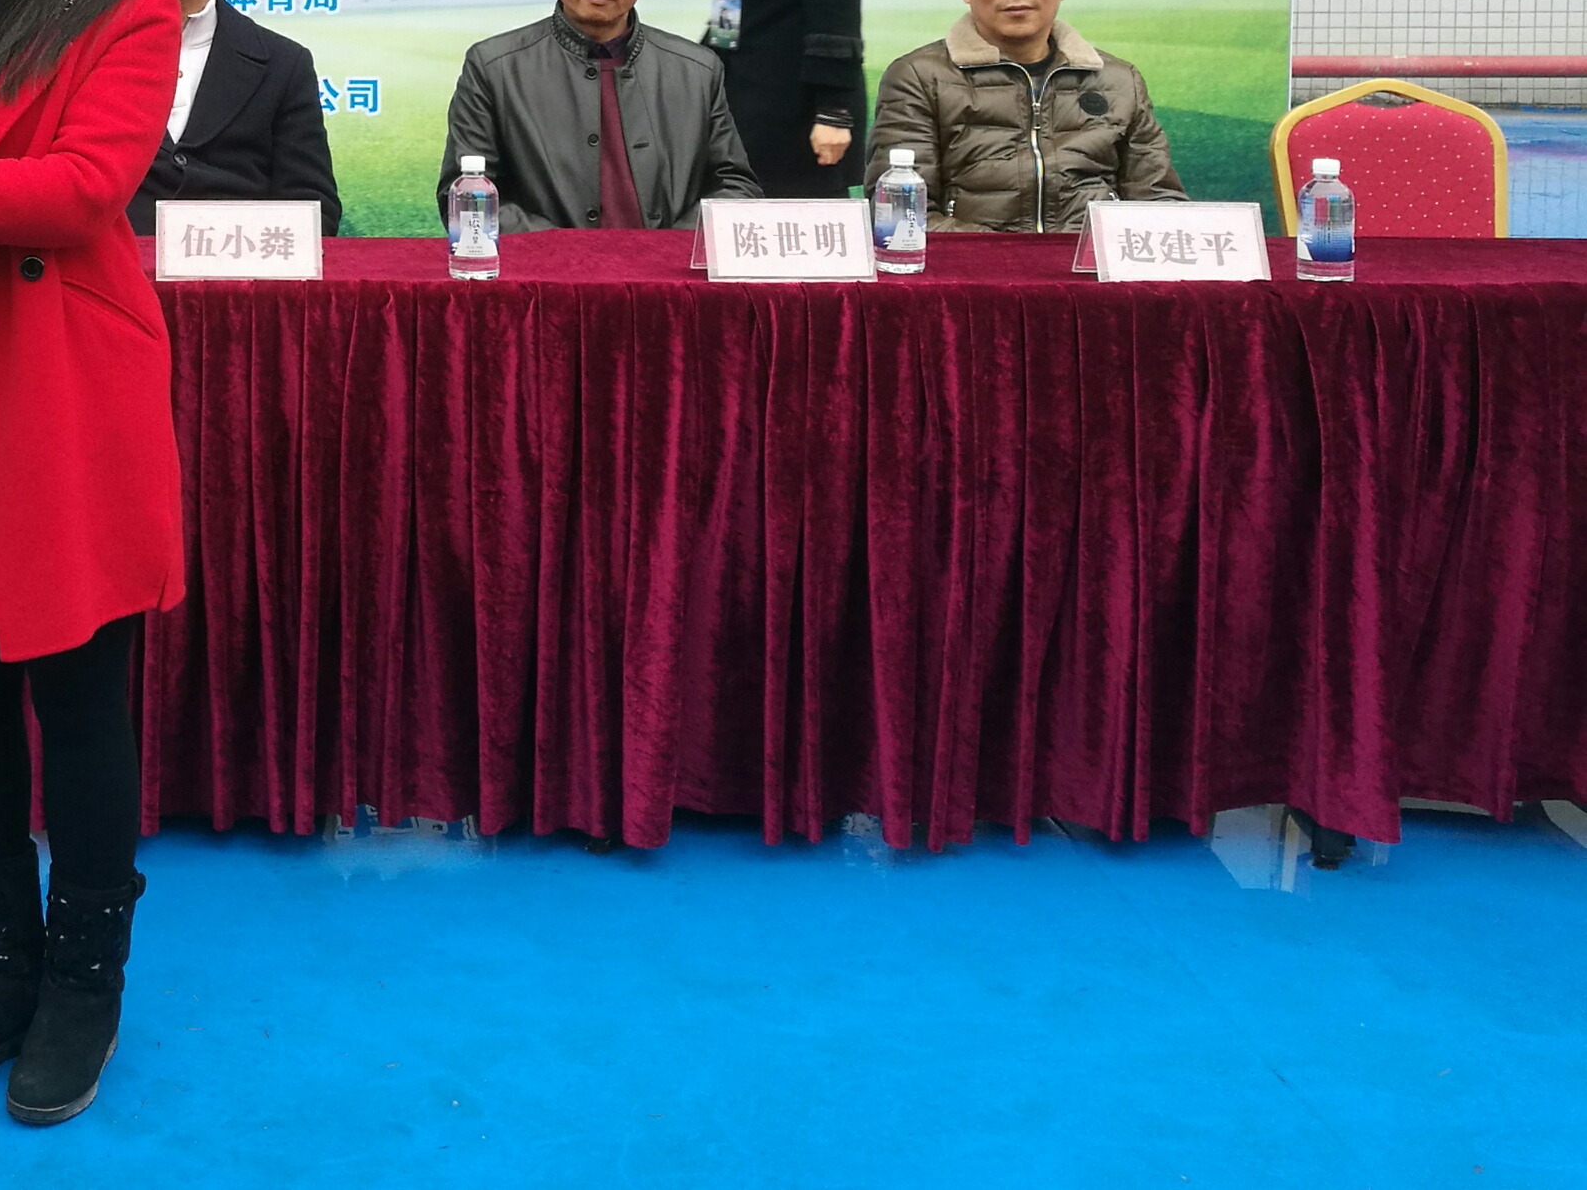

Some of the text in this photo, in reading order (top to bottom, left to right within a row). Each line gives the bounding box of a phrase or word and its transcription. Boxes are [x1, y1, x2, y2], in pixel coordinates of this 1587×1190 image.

[317, 78, 378, 112] 公司
[732, 221, 849, 258] 陈世明
[1117, 228, 1238, 266] 赵建平
